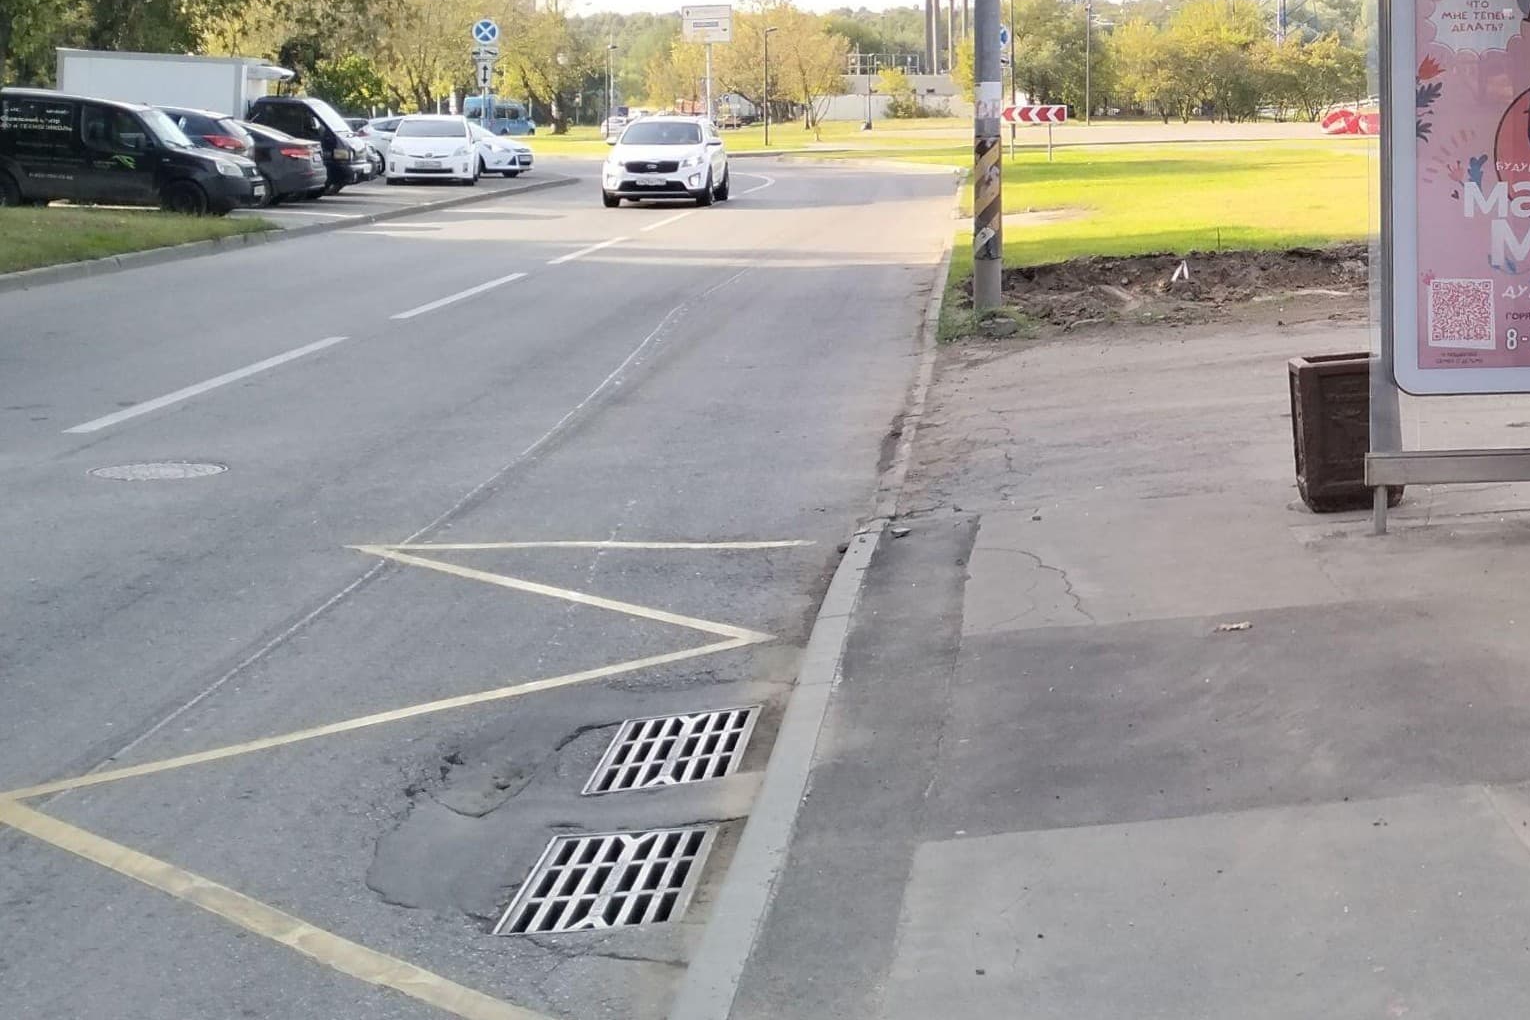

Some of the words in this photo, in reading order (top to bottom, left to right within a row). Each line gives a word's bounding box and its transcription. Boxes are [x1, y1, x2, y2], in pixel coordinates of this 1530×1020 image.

[1466, 0, 1489, 8] ЧТО
[1441, 11, 1468, 20] МНЕ
[1451, 22, 1503, 32] ДЕЛАТЬ?
